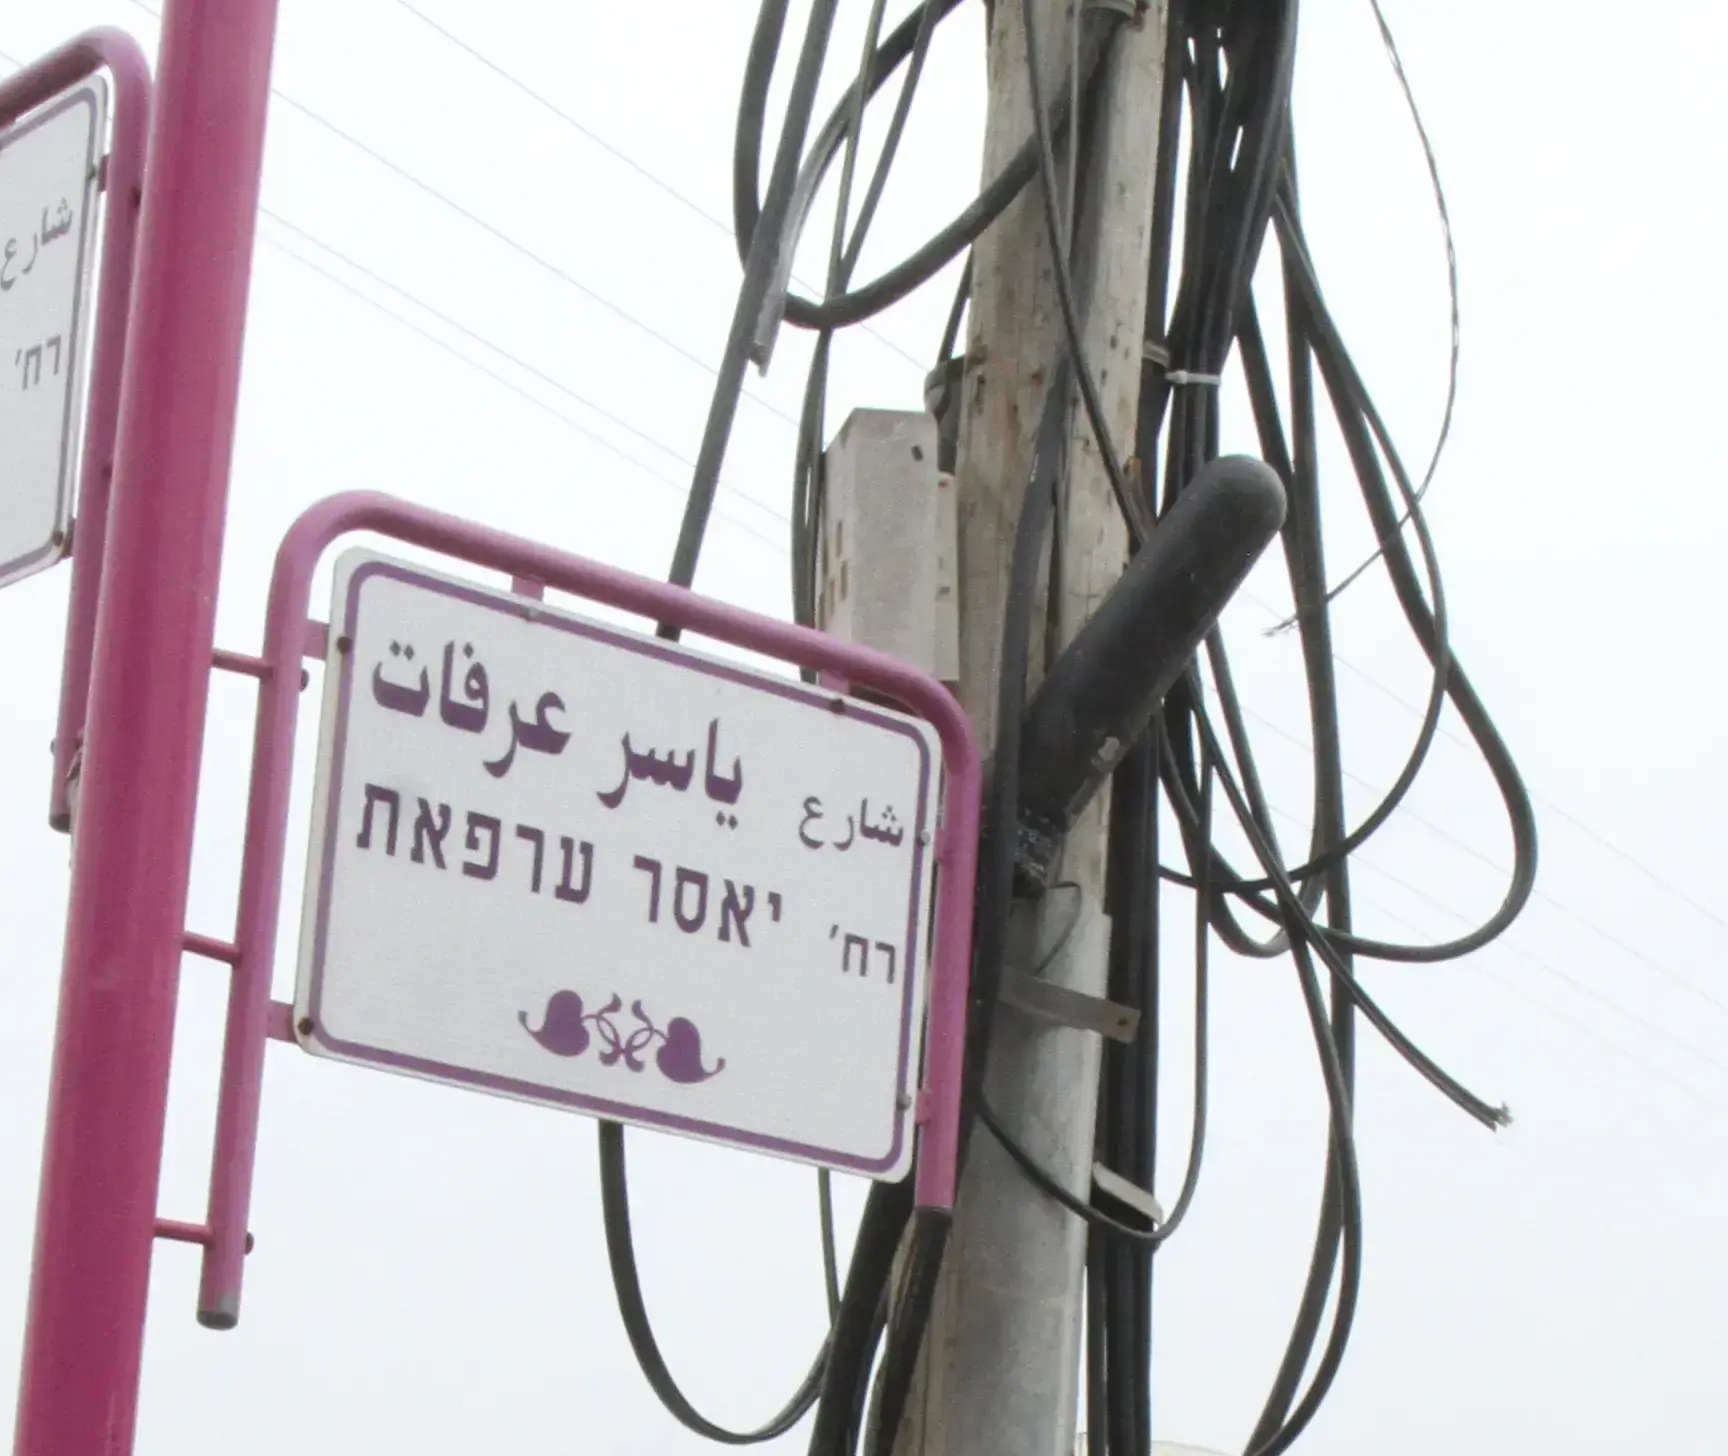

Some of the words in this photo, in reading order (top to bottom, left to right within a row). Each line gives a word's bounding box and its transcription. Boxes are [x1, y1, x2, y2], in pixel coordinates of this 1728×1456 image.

[14, 335, 62, 393] רח'
[372, 639, 571, 778] عرفات
[596, 718, 743, 830] ياسر
[356, 783, 595, 906] ערפאת
[797, 795, 904, 850] شارع
[633, 855, 783, 949] יאסר
[828, 924, 897, 985] רח'
